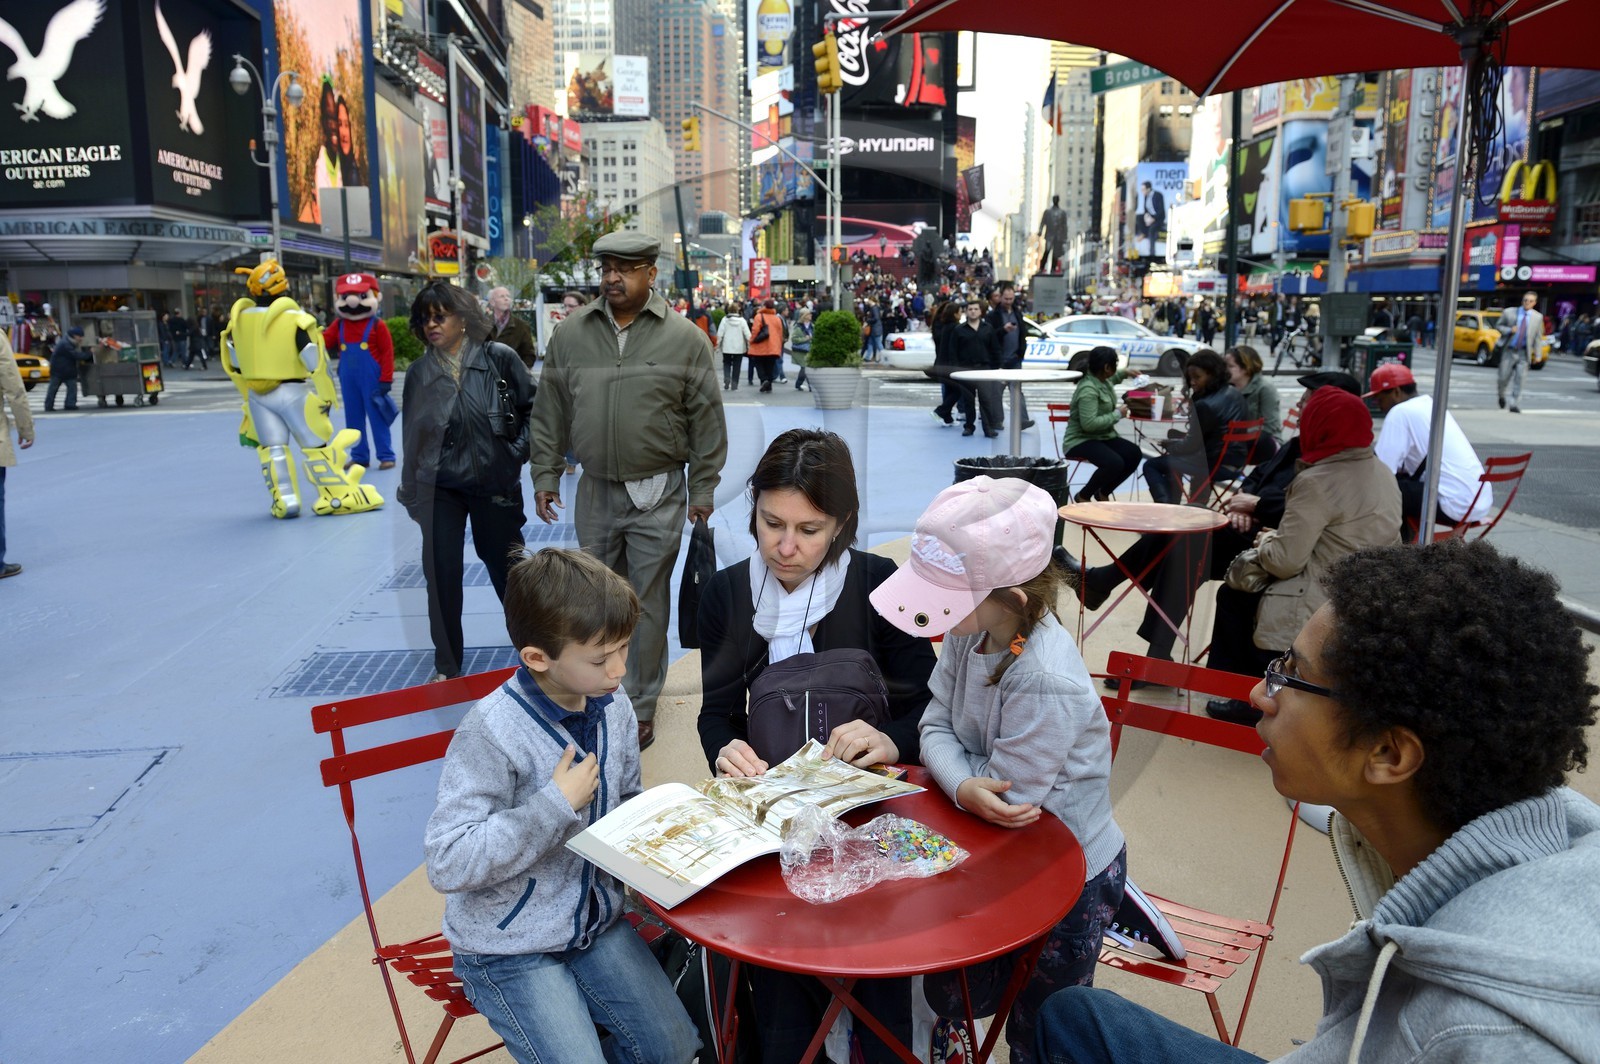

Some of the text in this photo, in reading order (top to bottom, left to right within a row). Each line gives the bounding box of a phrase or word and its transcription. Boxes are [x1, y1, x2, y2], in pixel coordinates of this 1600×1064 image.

[1105, 65, 1163, 85] Broad
[858, 137, 934, 152] HYUNDAI
[66, 145, 121, 162] EAGLE
[5, 164, 91, 180] OUTFITTERS
[158, 149, 223, 180] AMERICAN EAGLE
[173, 170, 212, 190] OUTFITTERS
[1155, 168, 1186, 180] men
[33, 179, 66, 189] ae.com
[104, 221, 165, 237] EAGLE
[169, 224, 246, 243] OUTFITTERS
[753, 260, 767, 287] tkts
[1025, 343, 1056, 356] YPD
[1121, 342, 1154, 353] NYPD
